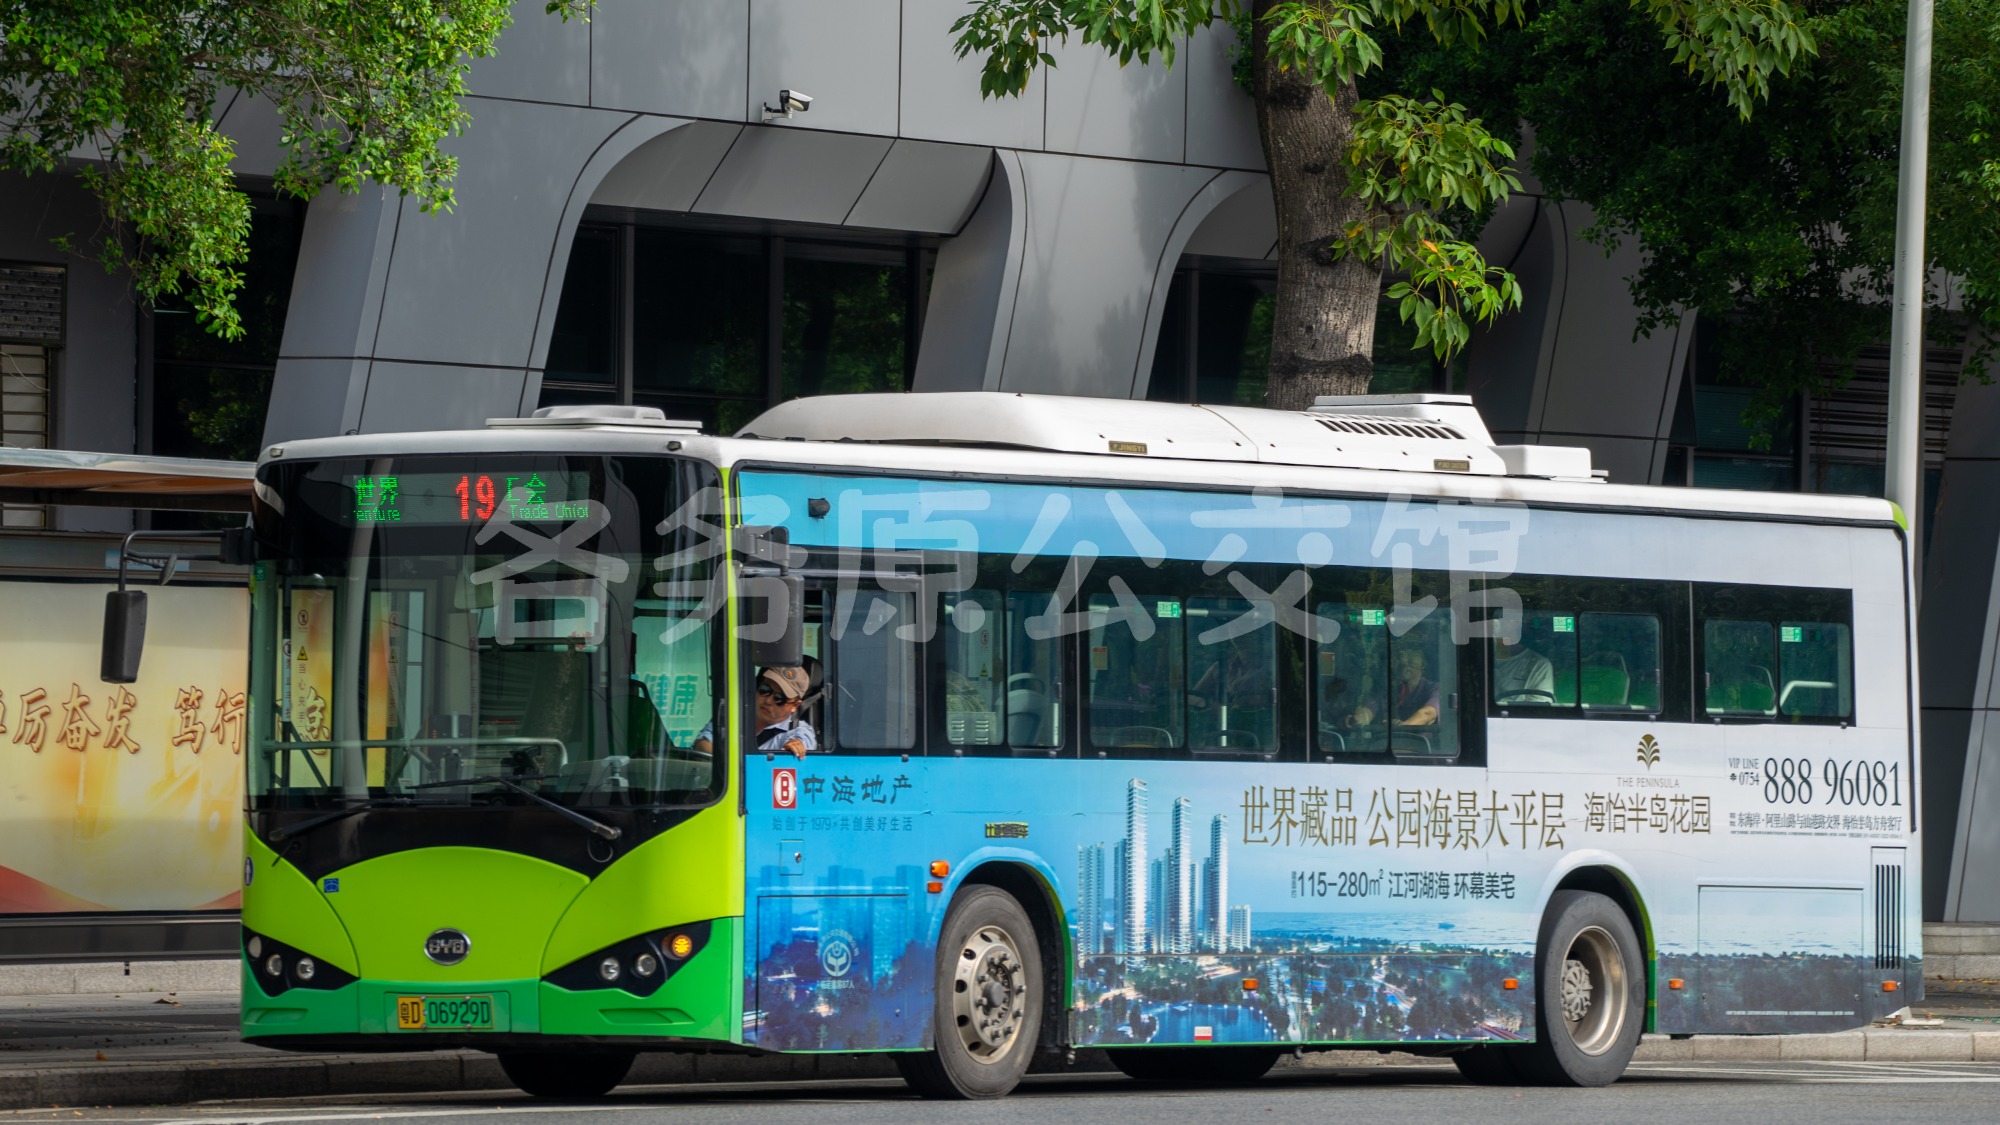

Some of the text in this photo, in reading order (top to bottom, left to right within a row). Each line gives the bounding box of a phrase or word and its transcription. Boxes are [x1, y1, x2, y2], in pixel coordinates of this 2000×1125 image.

[355, 477, 398, 506] 世界
[456, 475, 495, 520] 19
[354, 509, 401, 521] enture
[510, 504, 549, 519] Trade
[0, 683, 140, 754] 厉奋发
[1728, 758, 1760, 770] VIP LINE
[803, 774, 912, 804] 中海地产
[1617, 776, 1680, 789] THE PENINSULA
[1739, 773, 1760, 786] 0754
[1764, 757, 1902, 807] 888 96081
[1240, 785, 1566, 850] 世界藏品 公园海景大平层
[1584, 792, 1711, 835] 海怡半岛花园
[1388, 872, 1450, 900] 江河湖海
[1454, 872, 1515, 900] 环幕美宅
[428, 939, 466, 954] BYD
